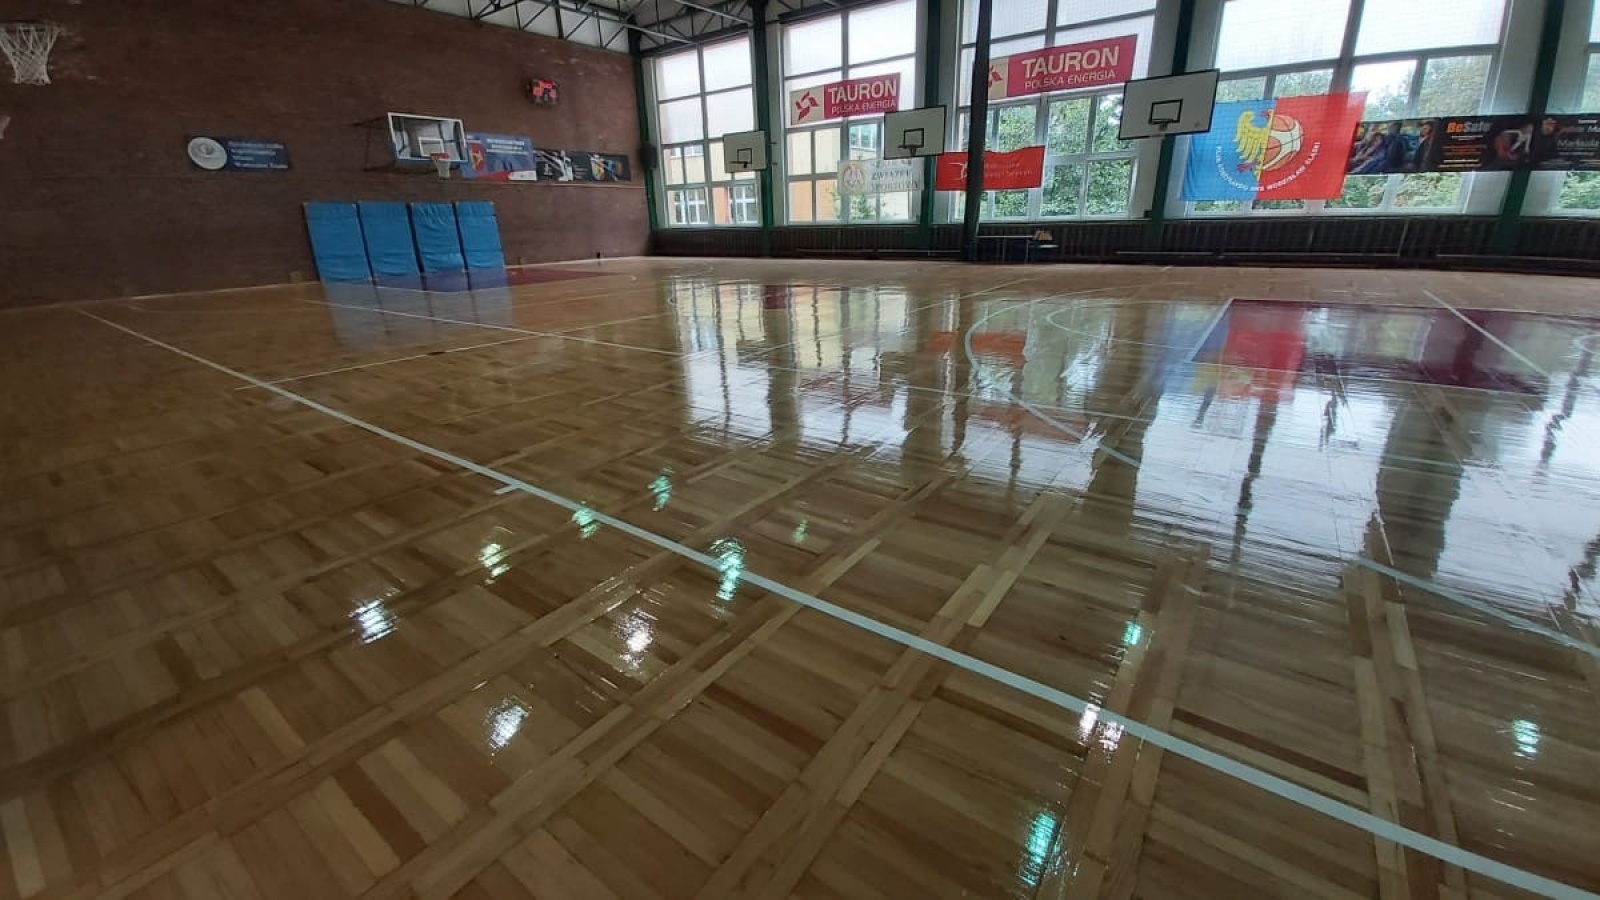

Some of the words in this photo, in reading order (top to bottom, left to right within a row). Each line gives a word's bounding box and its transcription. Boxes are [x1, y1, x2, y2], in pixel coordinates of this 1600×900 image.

[1022, 46, 1120, 78] TAURON
[828, 79, 897, 105] TAURON
[1025, 75, 1064, 91] POLSKA
[1068, 70, 1116, 85] ENERGIA
[832, 103, 860, 115] POLSKA
[862, 99, 896, 110] ENERGIA
